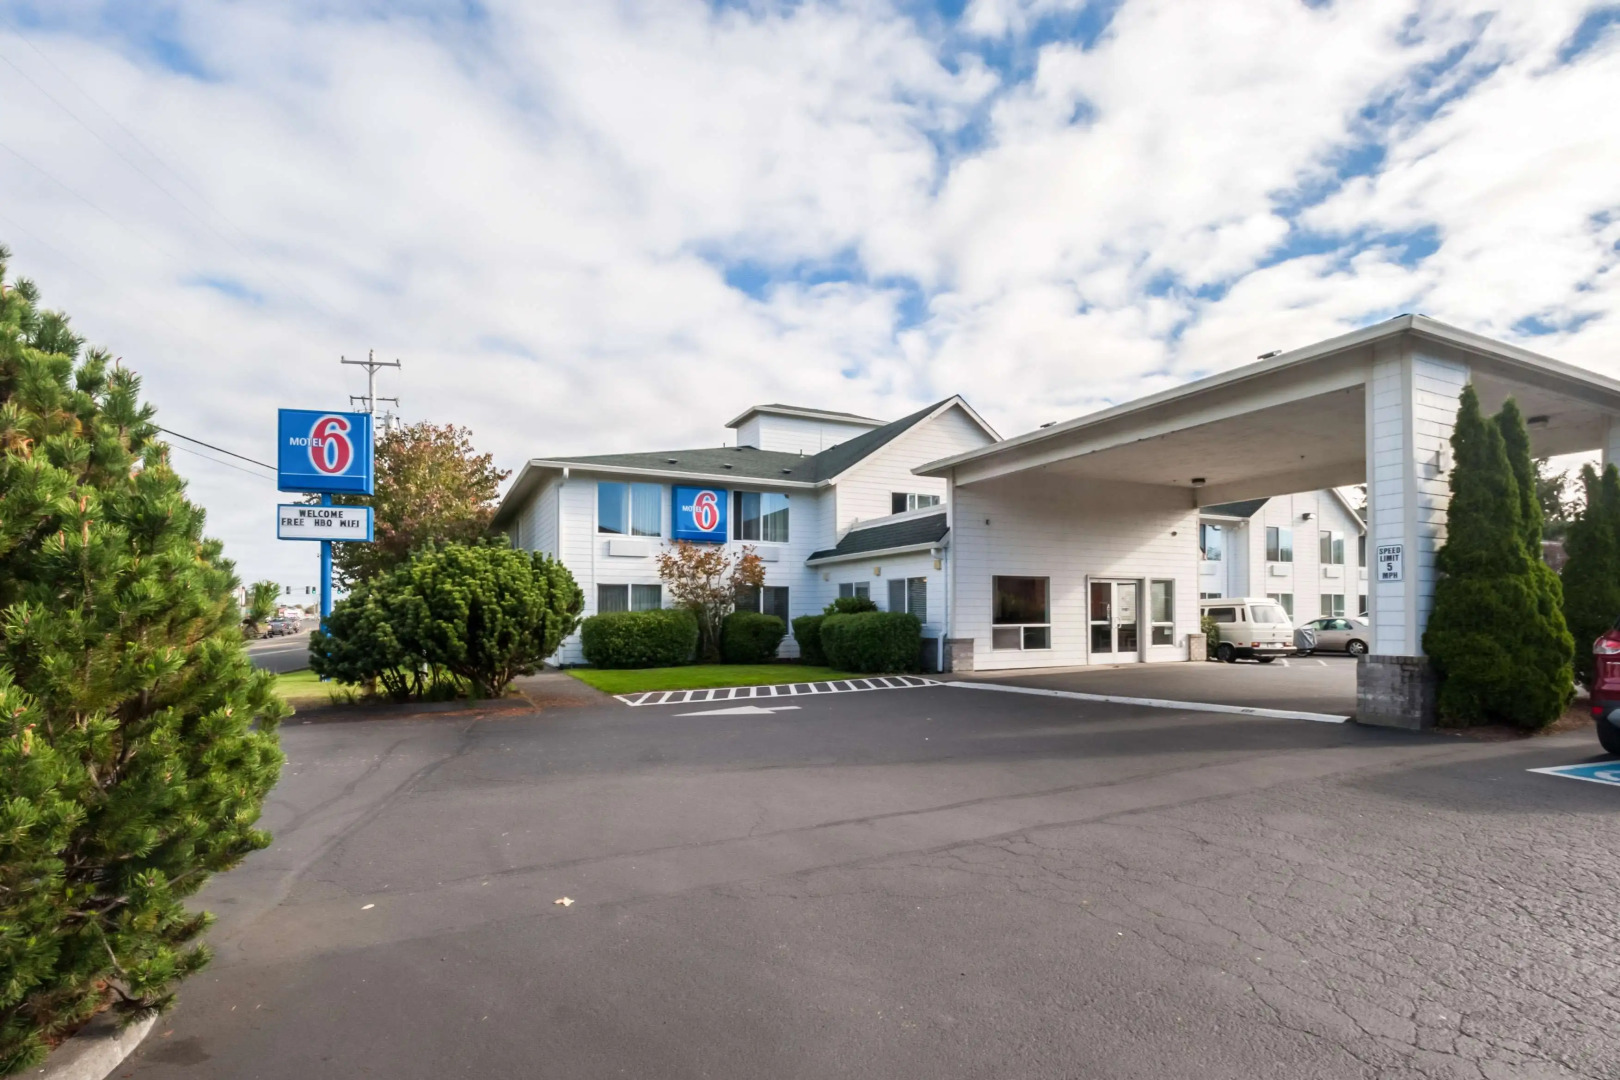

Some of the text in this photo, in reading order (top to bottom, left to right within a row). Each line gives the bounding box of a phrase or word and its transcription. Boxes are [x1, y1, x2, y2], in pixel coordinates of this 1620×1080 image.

[289, 415, 353, 475] MOTEL 6
[299, 509, 344, 519] WELCOME
[682, 490, 719, 532] MOTEL 6
[281, 518, 360, 528] FREE HBO WIFI
[1379, 547, 1401, 555] SPEED
[1380, 554, 1399, 562] LIMIT
[1386, 562, 1393, 571] 5
